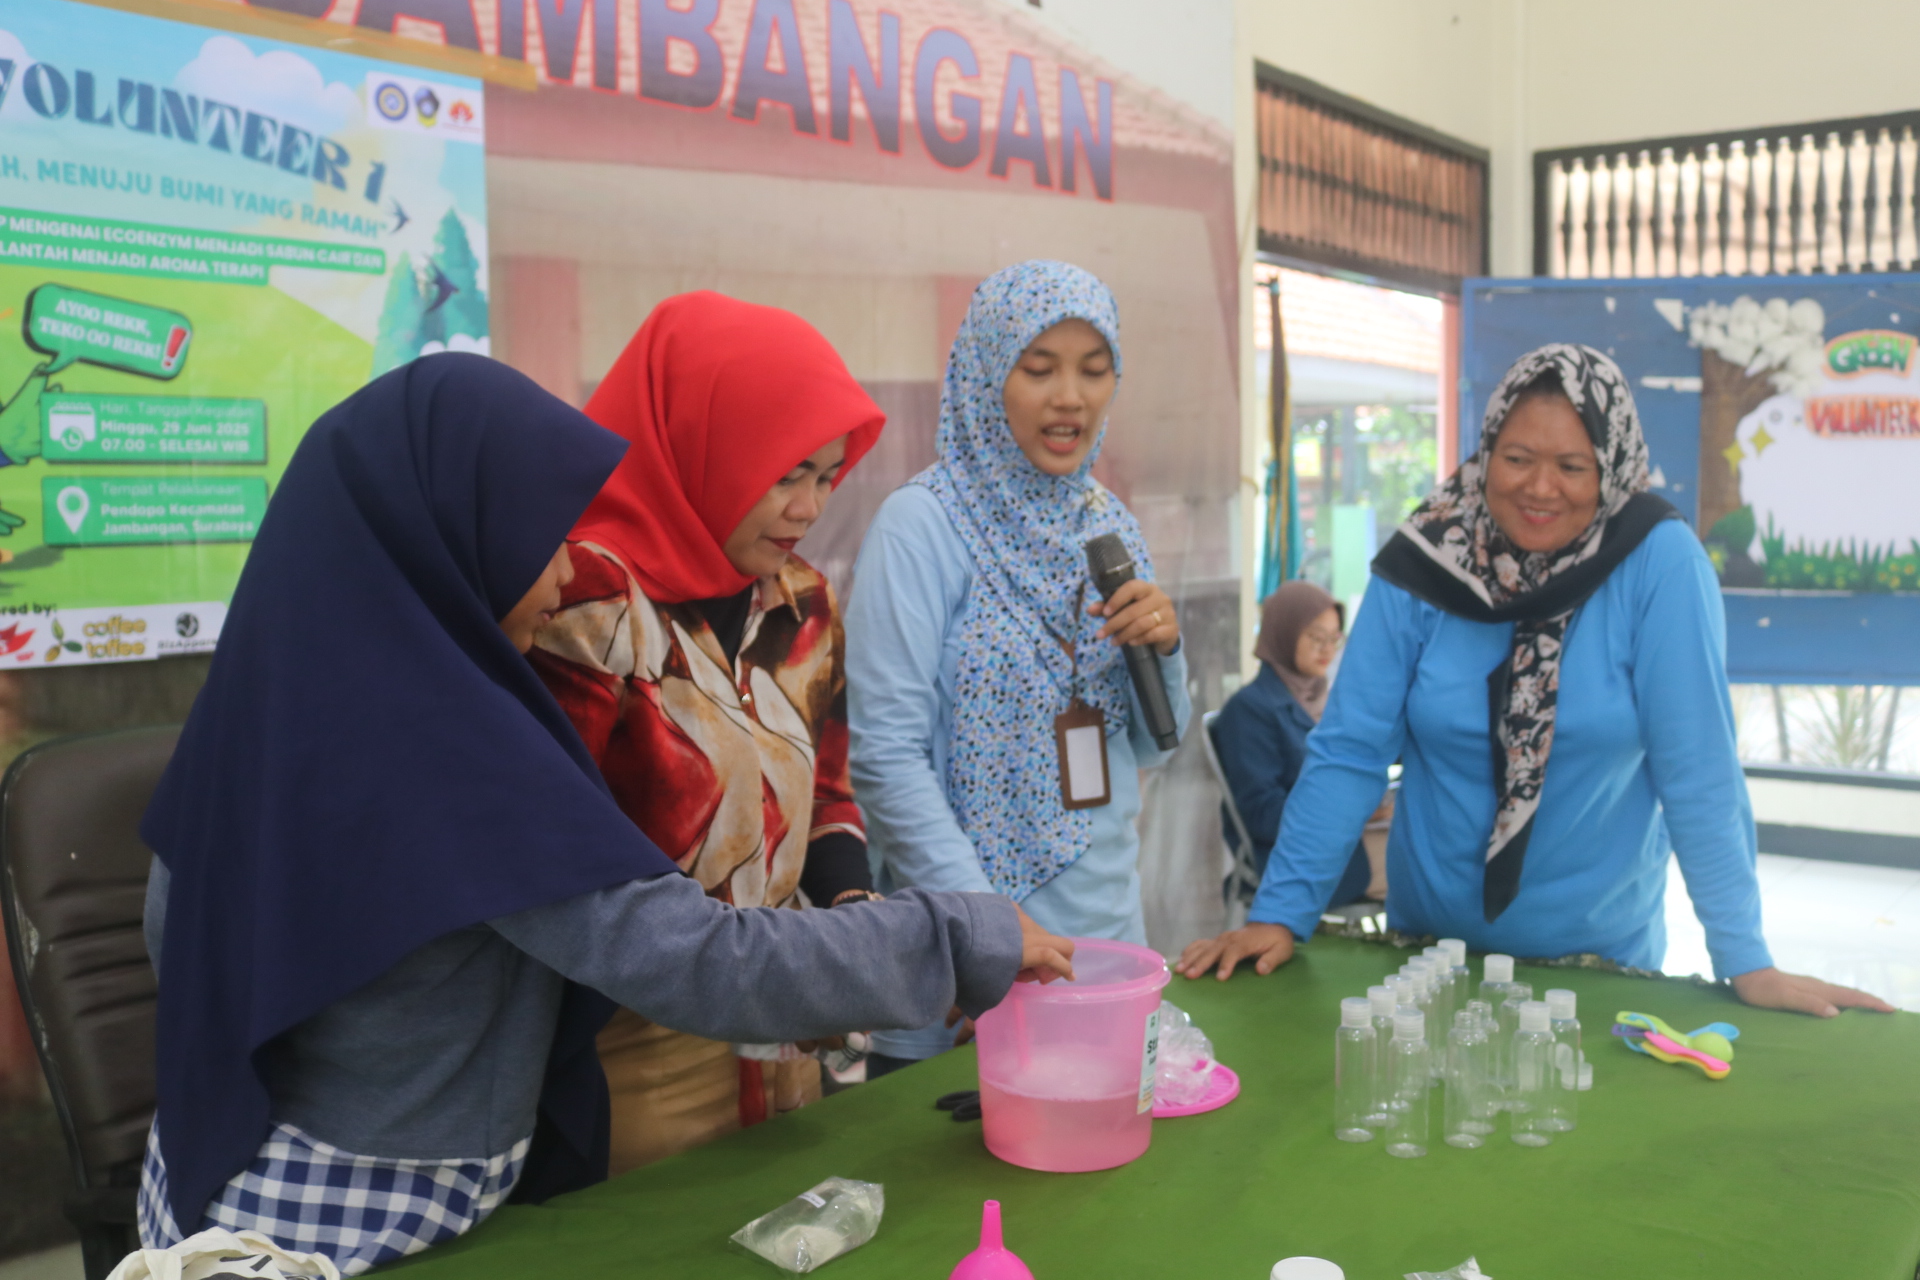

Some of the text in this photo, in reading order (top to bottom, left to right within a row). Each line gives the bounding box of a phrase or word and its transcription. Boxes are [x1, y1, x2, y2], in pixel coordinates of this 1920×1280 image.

[234, 0, 1116, 204] MBANGAN
[37, 159, 152, 195] MENUJU
[160, 176, 224, 208] BUMI
[231, 190, 294, 221] YANG
[9, 216, 101, 241] MENGENAI
[103, 226, 191, 251] ECOENZYM
[194, 235, 263, 257] MENJADI
[265, 243, 315, 263] SABUN
[317, 249, 351, 266] CAIR
[353, 252, 383, 269] DAN
[72, 247, 147, 270] MENJADI
[150, 255, 209, 276] AROMA
[211, 260, 265, 280] TERAPI
[54, 298, 100, 323] AYOO
[38, 315, 85, 342] TEKO
[162, 421, 180, 435] 29
[216, 422, 250, 436] 2025
[159, 438, 218, 453] SELESAI
[221, 440, 250, 453] WIB
[101, 503, 245, 518] Pendopo Kecamatan
[192, 519, 255, 534] Surabaya
[0, 601, 28, 616] red
[83, 614, 147, 637] coffee
[86, 638, 146, 660] toffee
